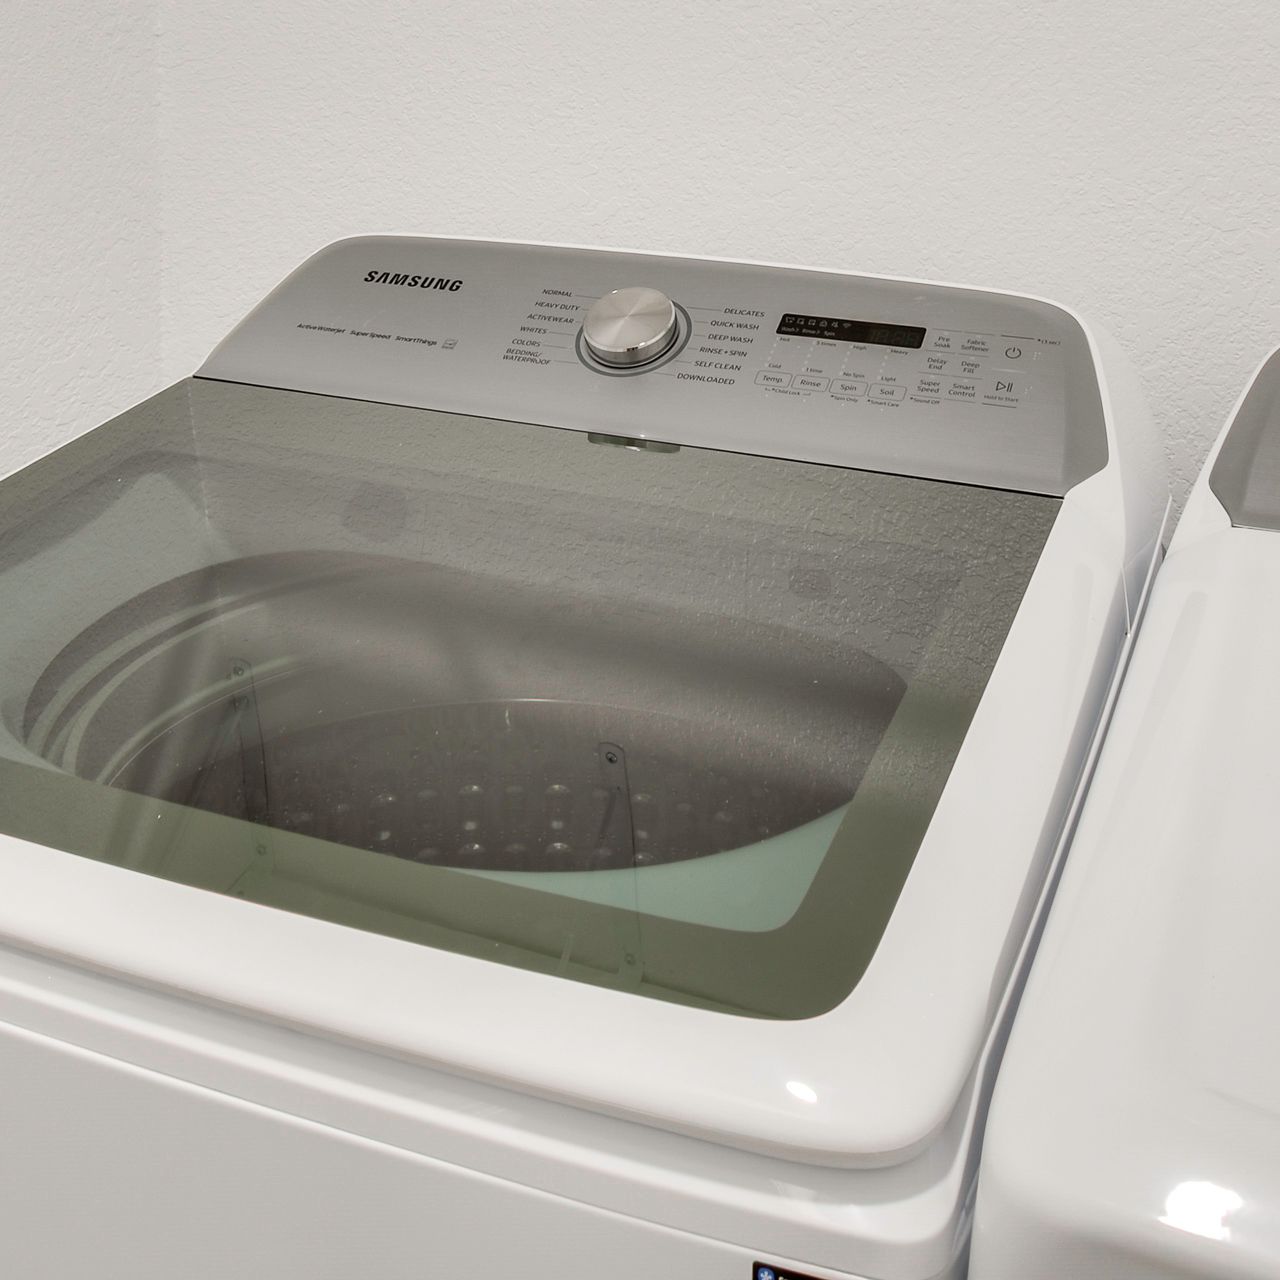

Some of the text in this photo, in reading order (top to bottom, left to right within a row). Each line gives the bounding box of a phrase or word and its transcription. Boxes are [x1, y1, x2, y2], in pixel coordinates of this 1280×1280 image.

[364, 270, 463, 292] SAMSUNG
[542, 289, 572, 297] NORMAL
[724, 308, 765, 317] DELICATES
[527, 313, 574, 323] ACTIVEWEAR
[710, 320, 735, 328] QUICK
[520, 326, 547, 334] WHITES
[512, 338, 541, 347] COLORS
[699, 347, 724, 355] RINSE
[961, 344, 989, 352] Softener
[503, 354, 551, 365] WATERPROOF
[927, 357, 947, 365] Delay
[715, 362, 742, 371] CLEAN
[677, 372, 735, 385] DOWNLOADED
[800, 379, 821, 387] Rinse
[920, 379, 940, 387] Super
[840, 384, 857, 392] Spin
[917, 385, 940, 393] Speed
[948, 389, 976, 397] Control
